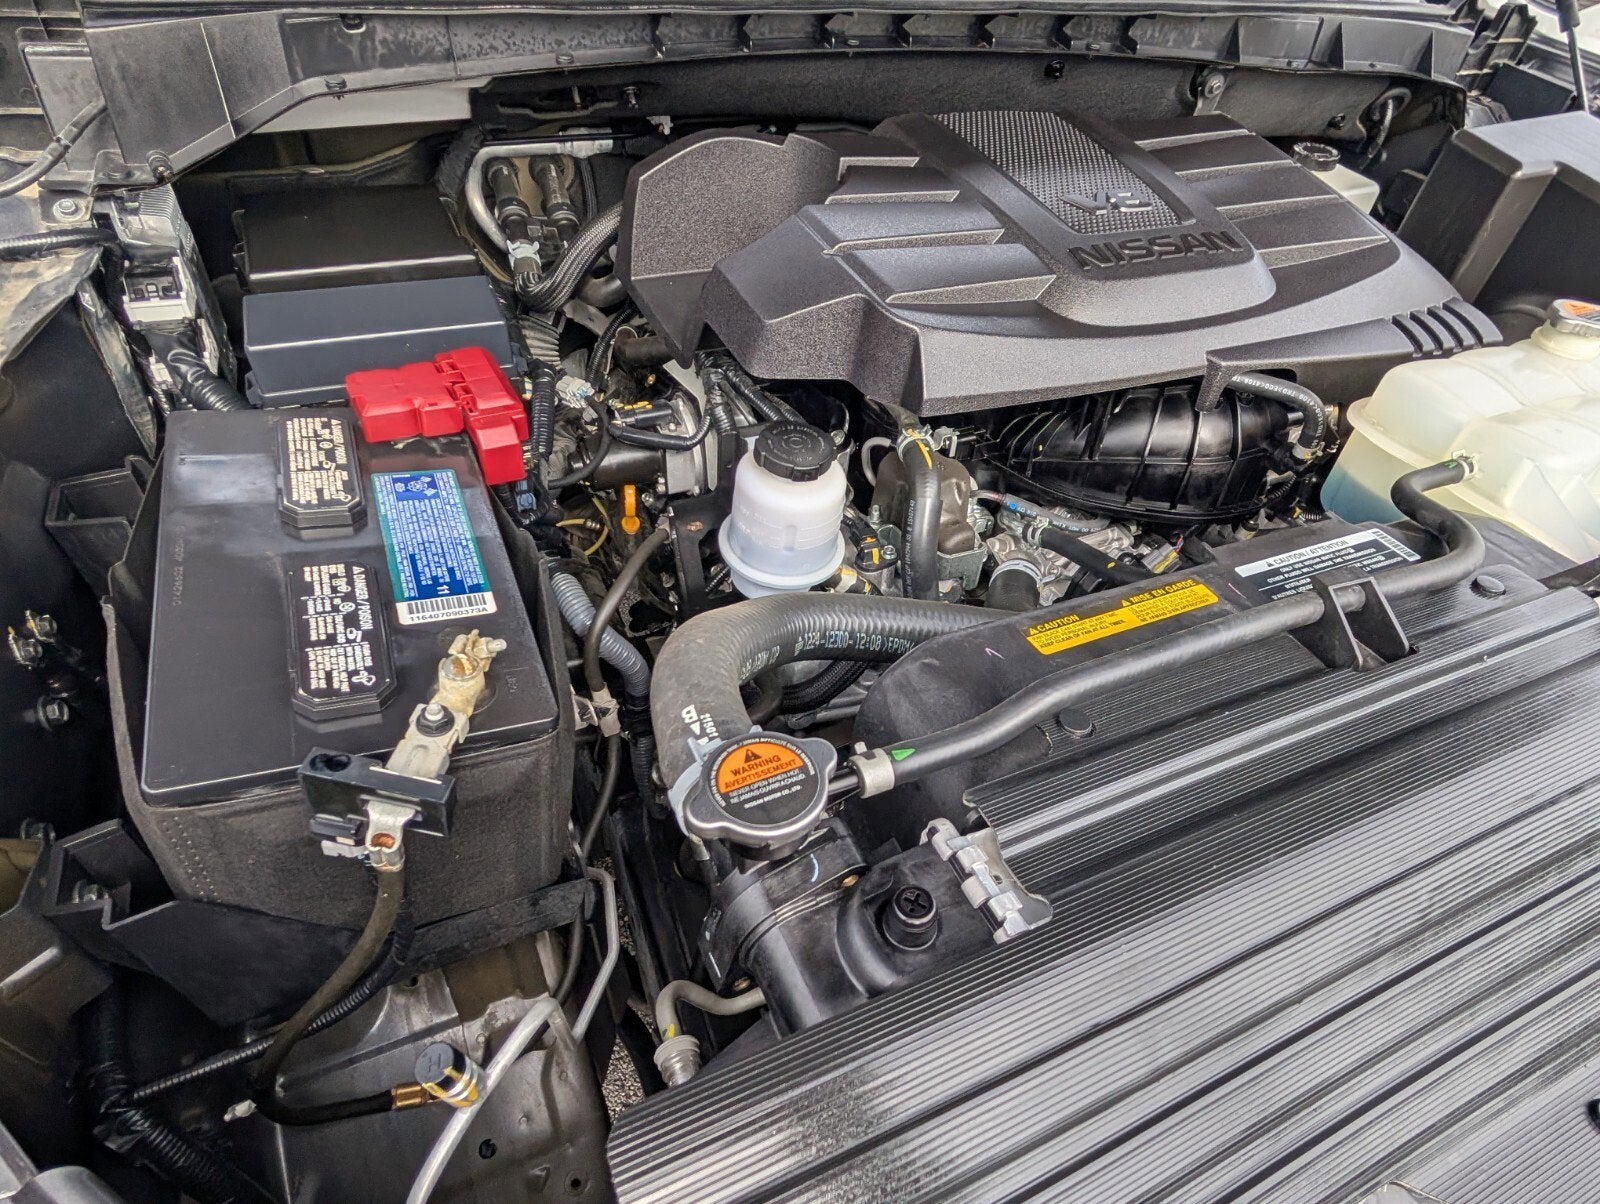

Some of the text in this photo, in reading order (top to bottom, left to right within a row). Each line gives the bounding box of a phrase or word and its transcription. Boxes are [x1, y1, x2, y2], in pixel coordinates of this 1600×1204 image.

[1068, 230, 1244, 270] NISSAN
[1274, 552, 1306, 564] CAUTION
[1310, 540, 1349, 555] ATTENTION
[1267, 575, 1285, 583] OTHER
[1284, 570, 1302, 578] FLUIDS
[1130, 579, 1196, 603] MISE EN GARDE
[1037, 614, 1079, 632] CAUTION
[1040, 641, 1054, 649] KEEP
[1056, 635, 1072, 644] CLEAR
[724, 759, 797, 789] AVERTISSEMENT
[730, 755, 781, 777] WARNING
[729, 787, 751, 797] NEVER
[751, 780, 768, 790] OPEN
[768, 774, 788, 784] WHEN
